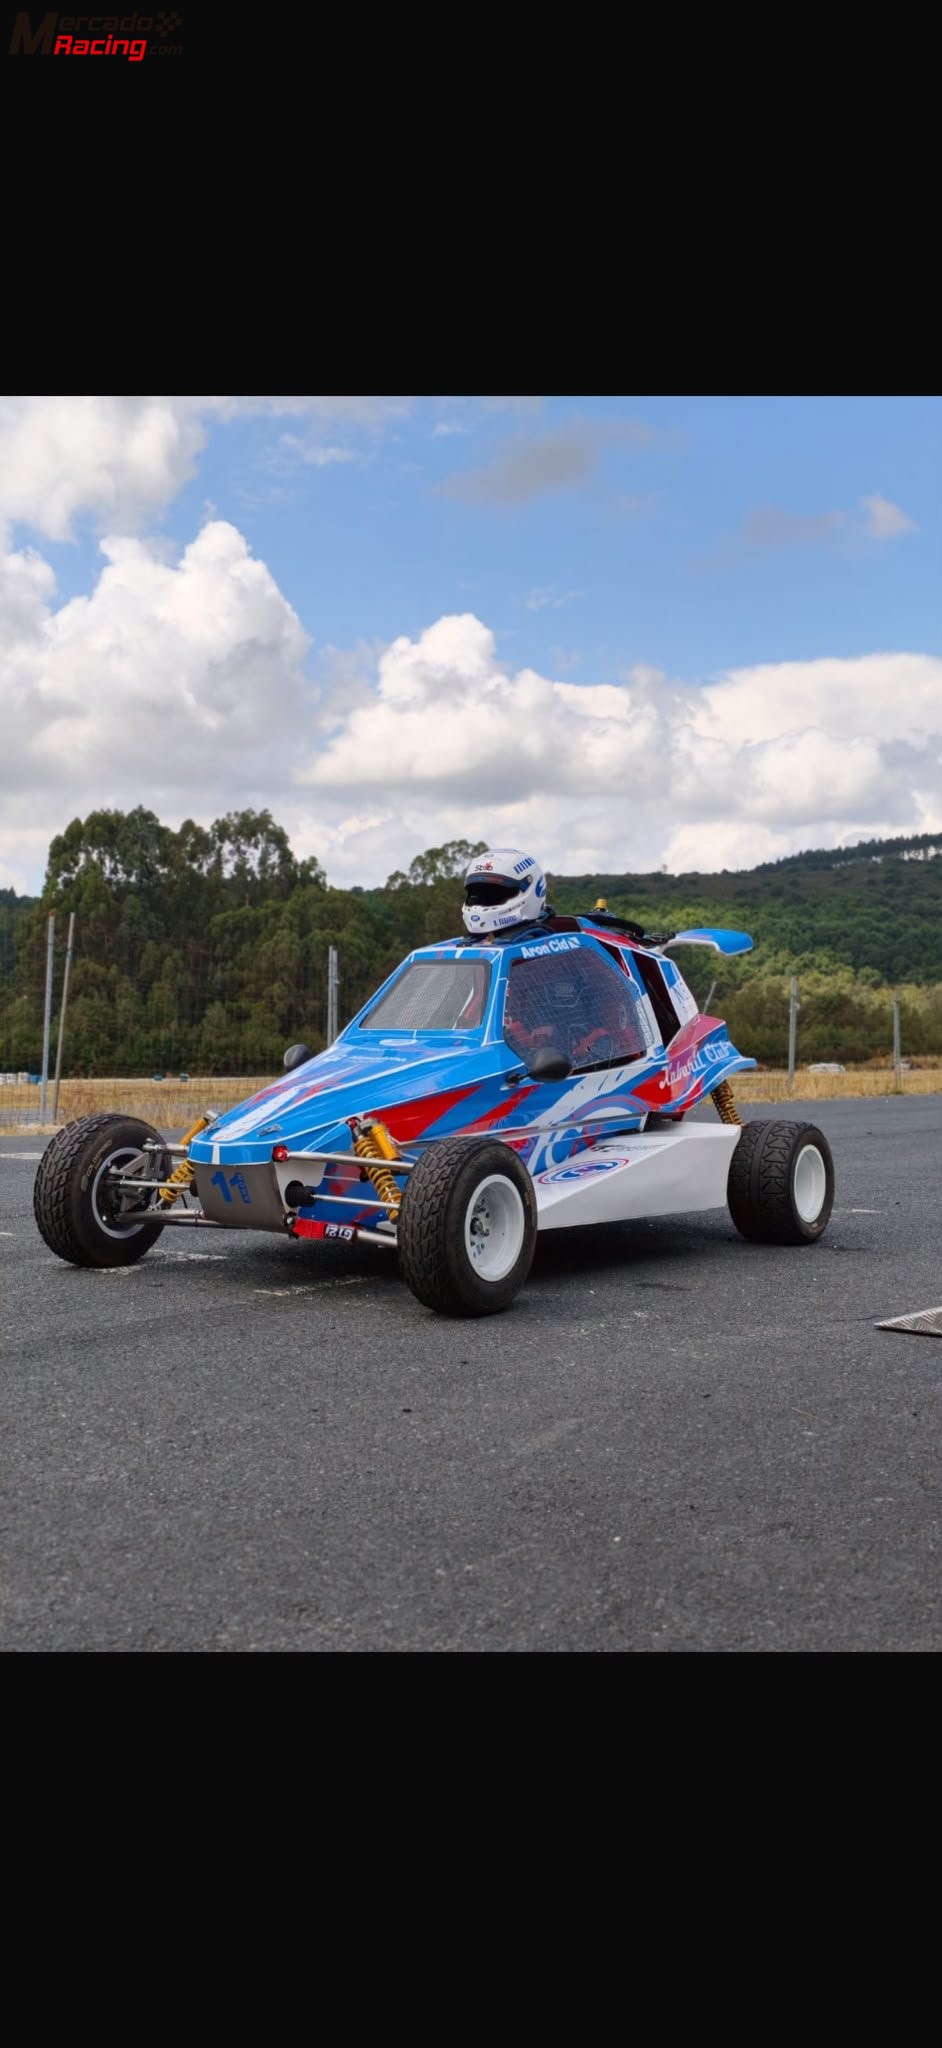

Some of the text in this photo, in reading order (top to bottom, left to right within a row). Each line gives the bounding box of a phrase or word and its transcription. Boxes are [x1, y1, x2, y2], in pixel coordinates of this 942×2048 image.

[521, 938, 570, 960] Aron Cid
[211, 1171, 252, 1204] 11
